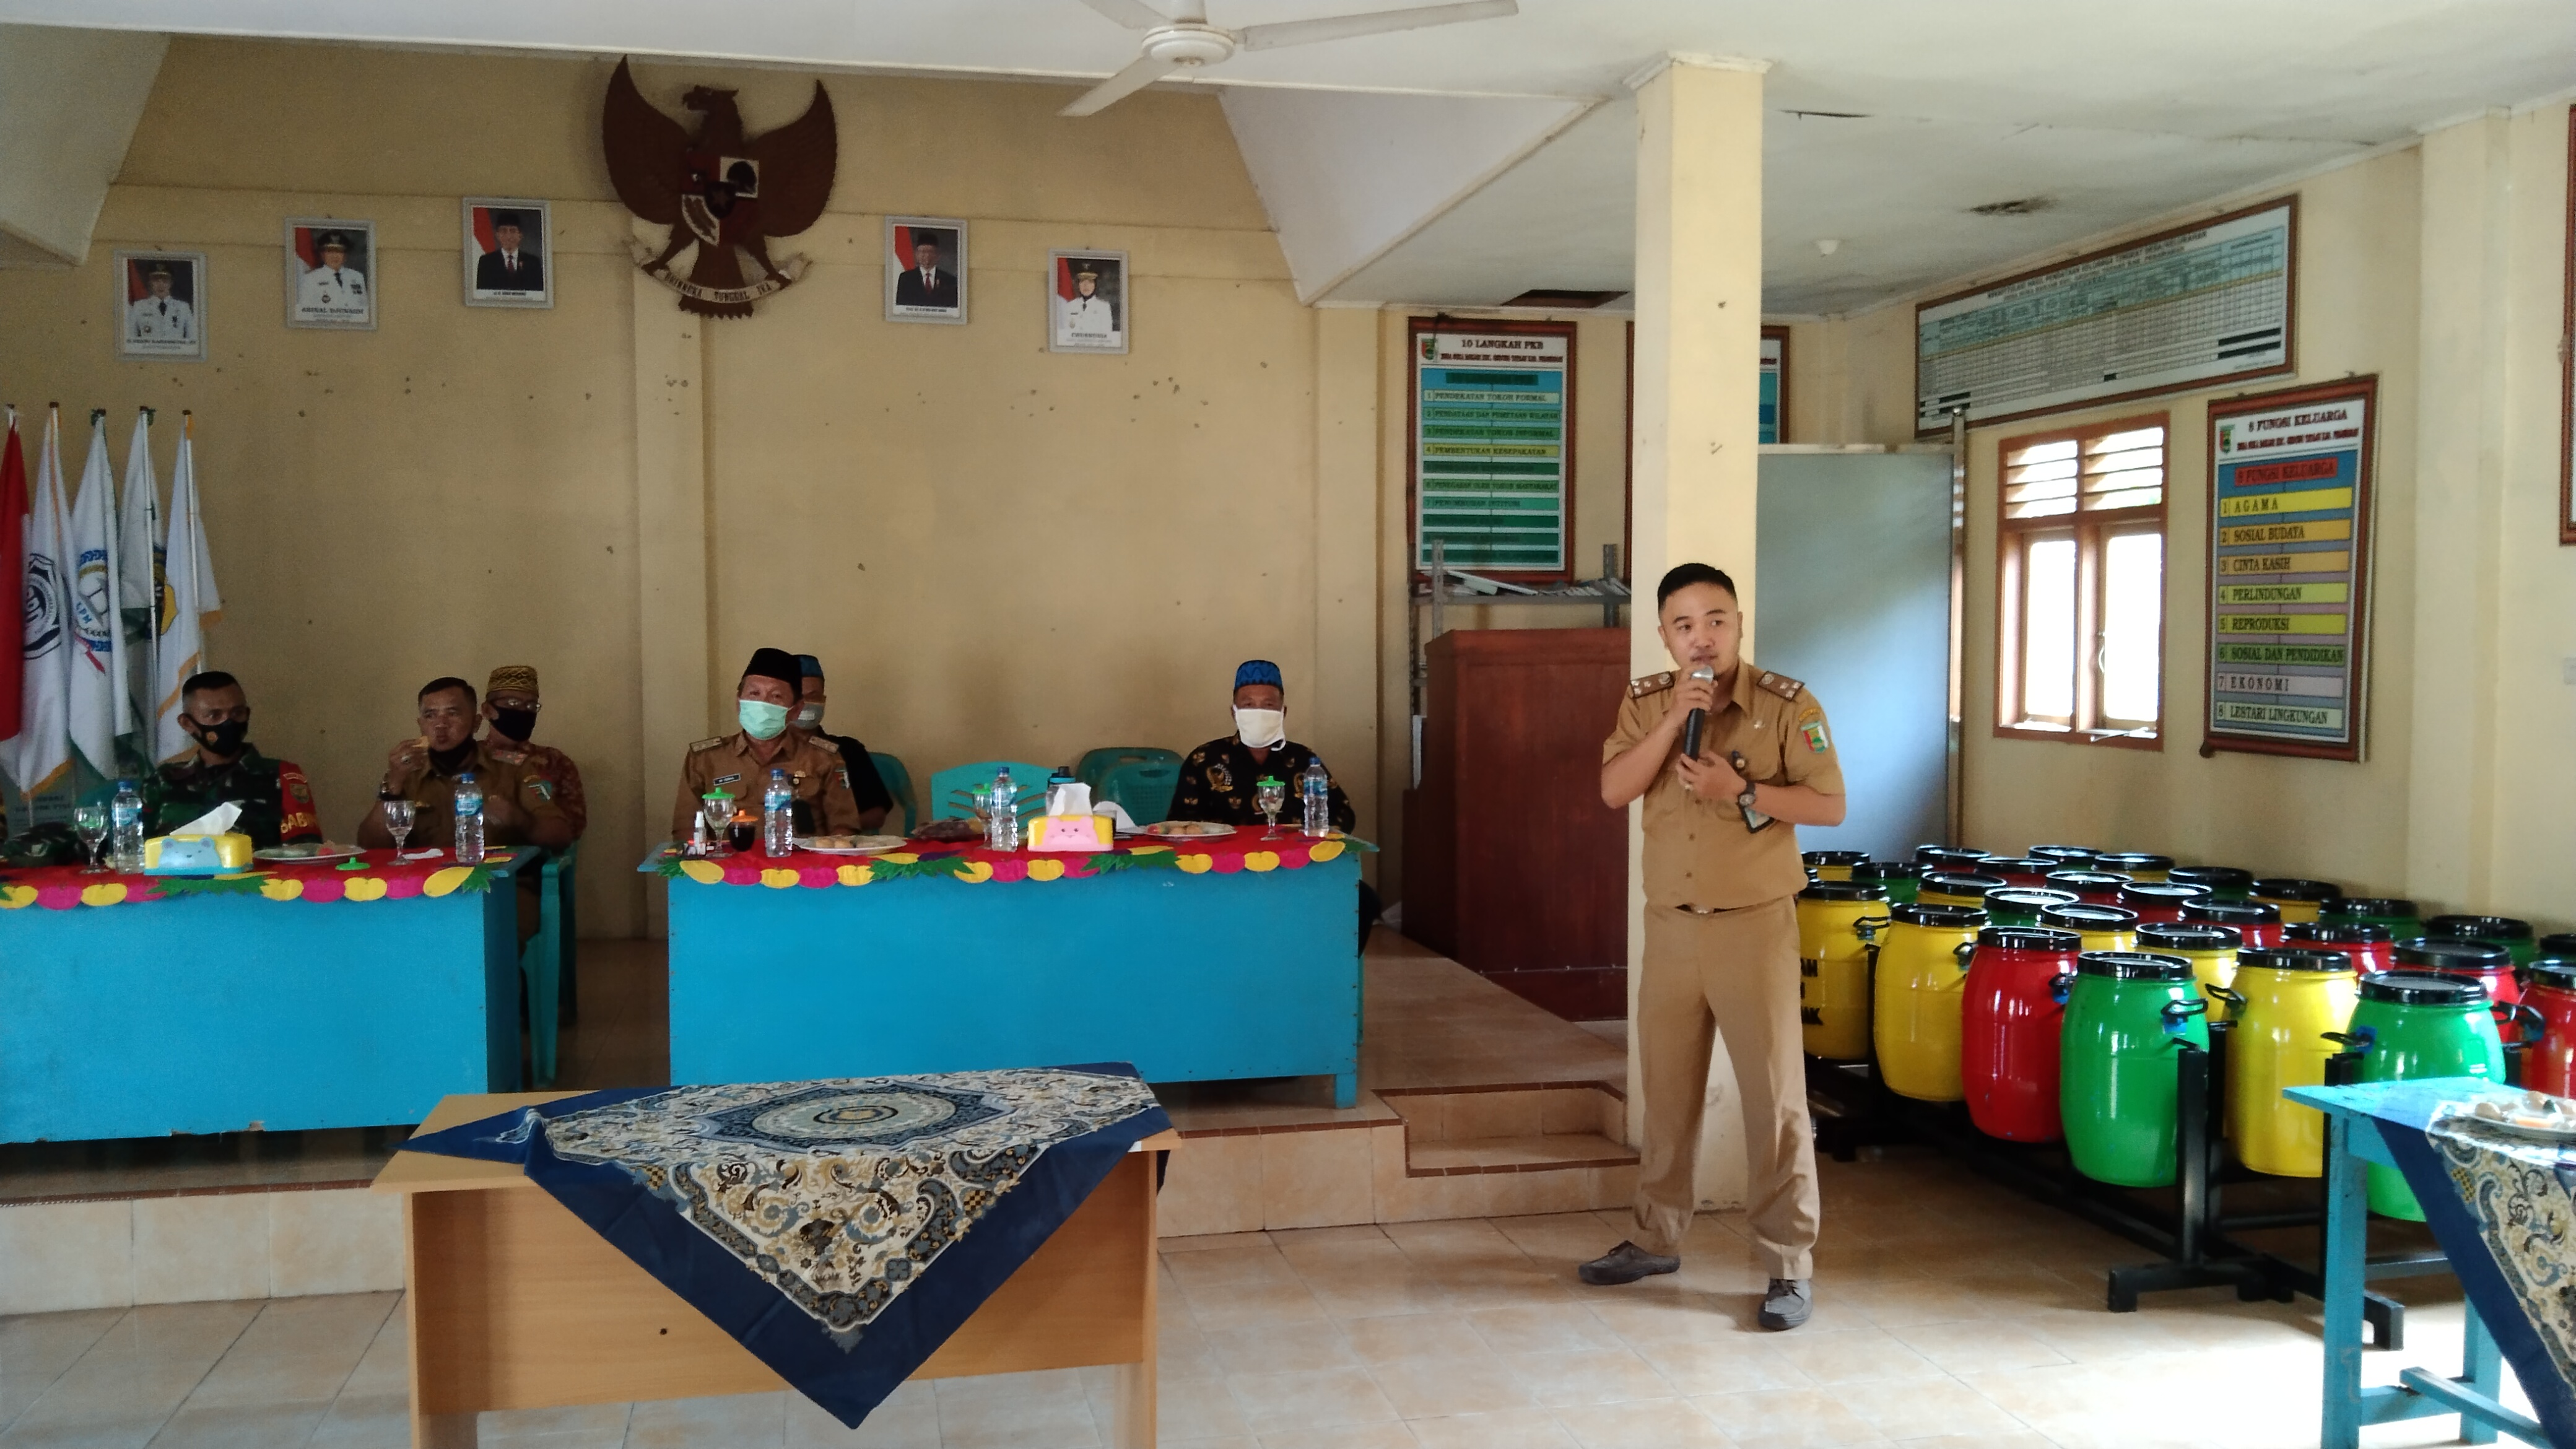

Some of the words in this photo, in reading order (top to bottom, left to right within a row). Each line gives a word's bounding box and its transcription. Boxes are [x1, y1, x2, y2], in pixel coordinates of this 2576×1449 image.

[1462, 339, 1472, 348] 10
[1476, 340, 1521, 349] LANGKAH
[2257, 416, 2291, 432] FUNGSI
[2294, 409, 2348, 426] KELUARGA
[2223, 502, 2227, 514] 1
[2221, 531, 2227, 543] 2
[2234, 528, 2266, 542] SOSIAL
[2268, 525, 2305, 540] BUDAYA
[2221, 560, 2227, 572] 3
[2233, 558, 2260, 571] CINTA
[2262, 557, 2291, 570] KASIH
[2221, 589, 2226, 601] 4
[2232, 586, 2302, 601] PERLINDUNGAN
[2220, 618, 2226, 630] 5
[2232, 617, 2290, 630] REPRODUKSI
[2231, 647, 2261, 660] SOSIAL
[2265, 648, 2283, 661] DAN
[2286, 648, 2344, 662] PENDIDIKAN
[2219, 676, 2224, 688] 7
[2219, 705, 2223, 716] 8
[2230, 705, 2266, 720] LESTARI
[2268, 708, 2328, 724] LINGKUNGAN
